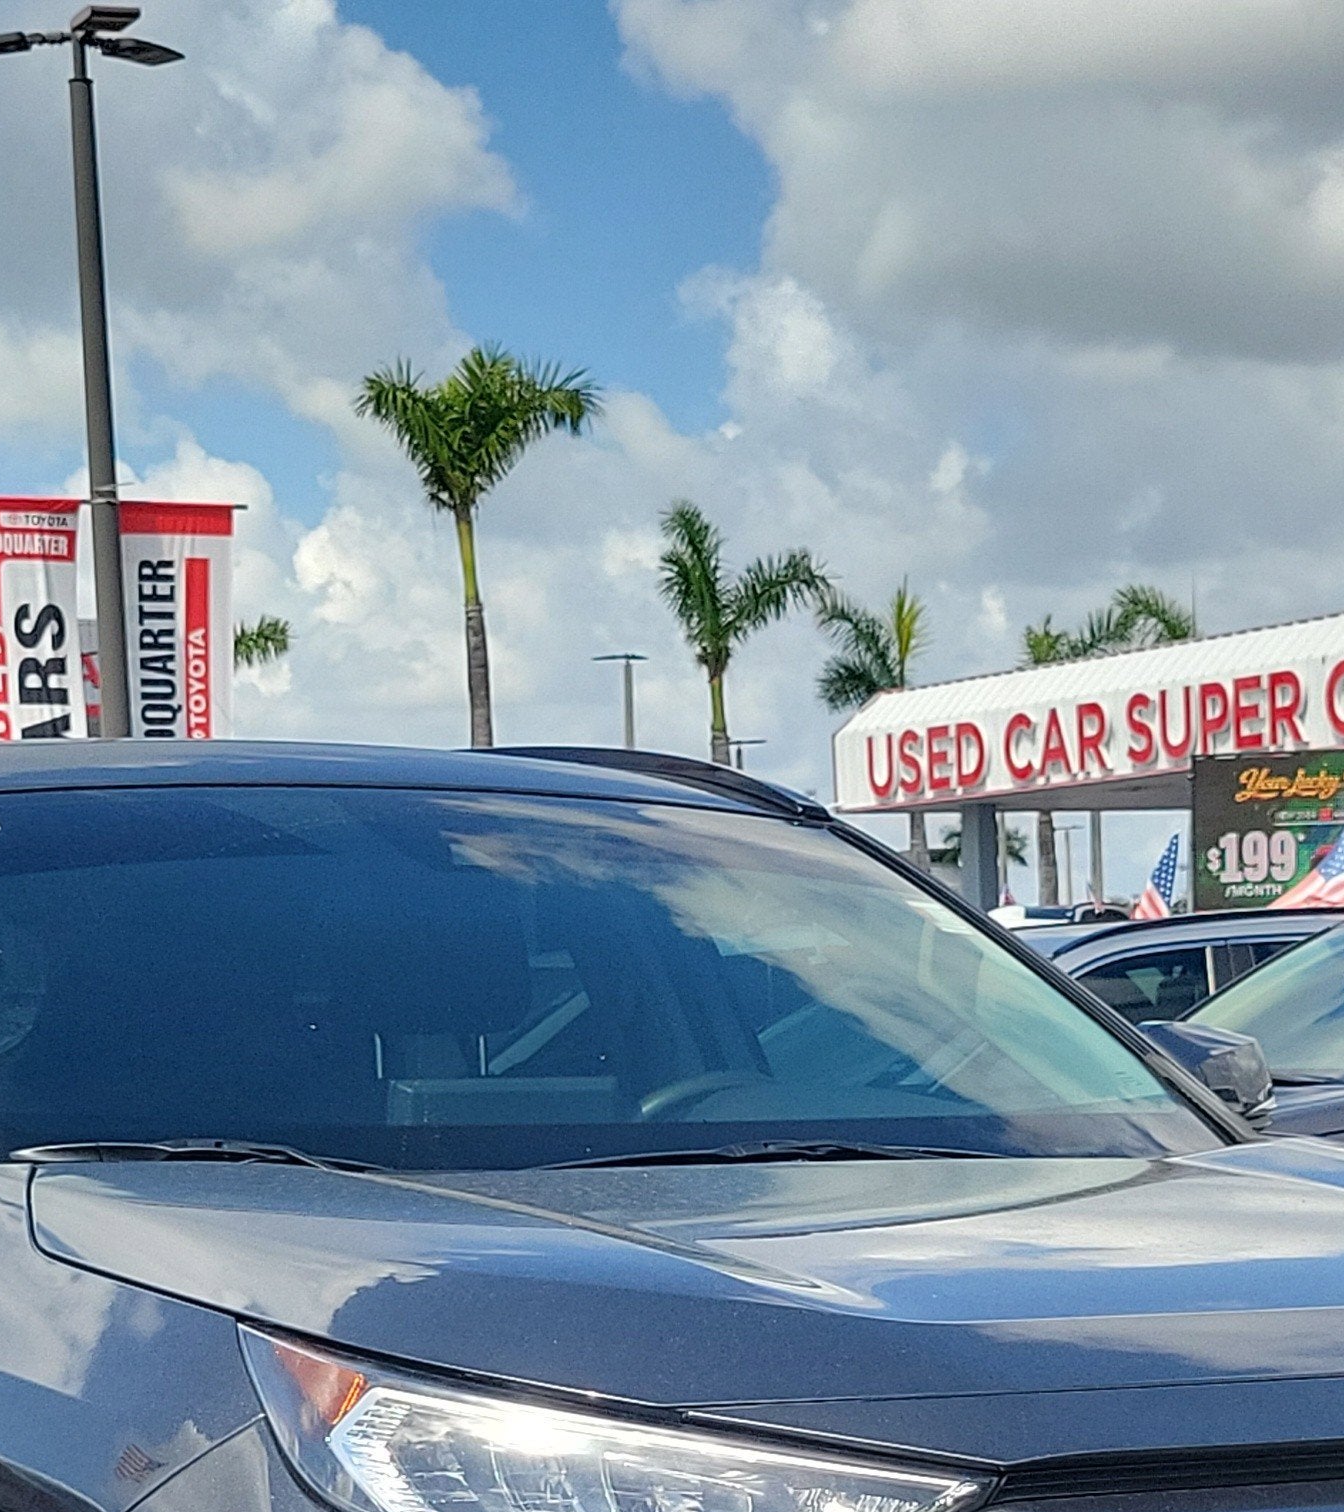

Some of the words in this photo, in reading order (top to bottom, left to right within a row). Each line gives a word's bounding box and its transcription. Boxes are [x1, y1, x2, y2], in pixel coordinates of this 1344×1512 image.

[24, 514, 68, 527] TOYOTA
[188, 627, 207, 729] TOYOTA
[867, 732, 985, 798] USED
[1003, 701, 1112, 781] CAR
[1126, 669, 1304, 764] SUPER
